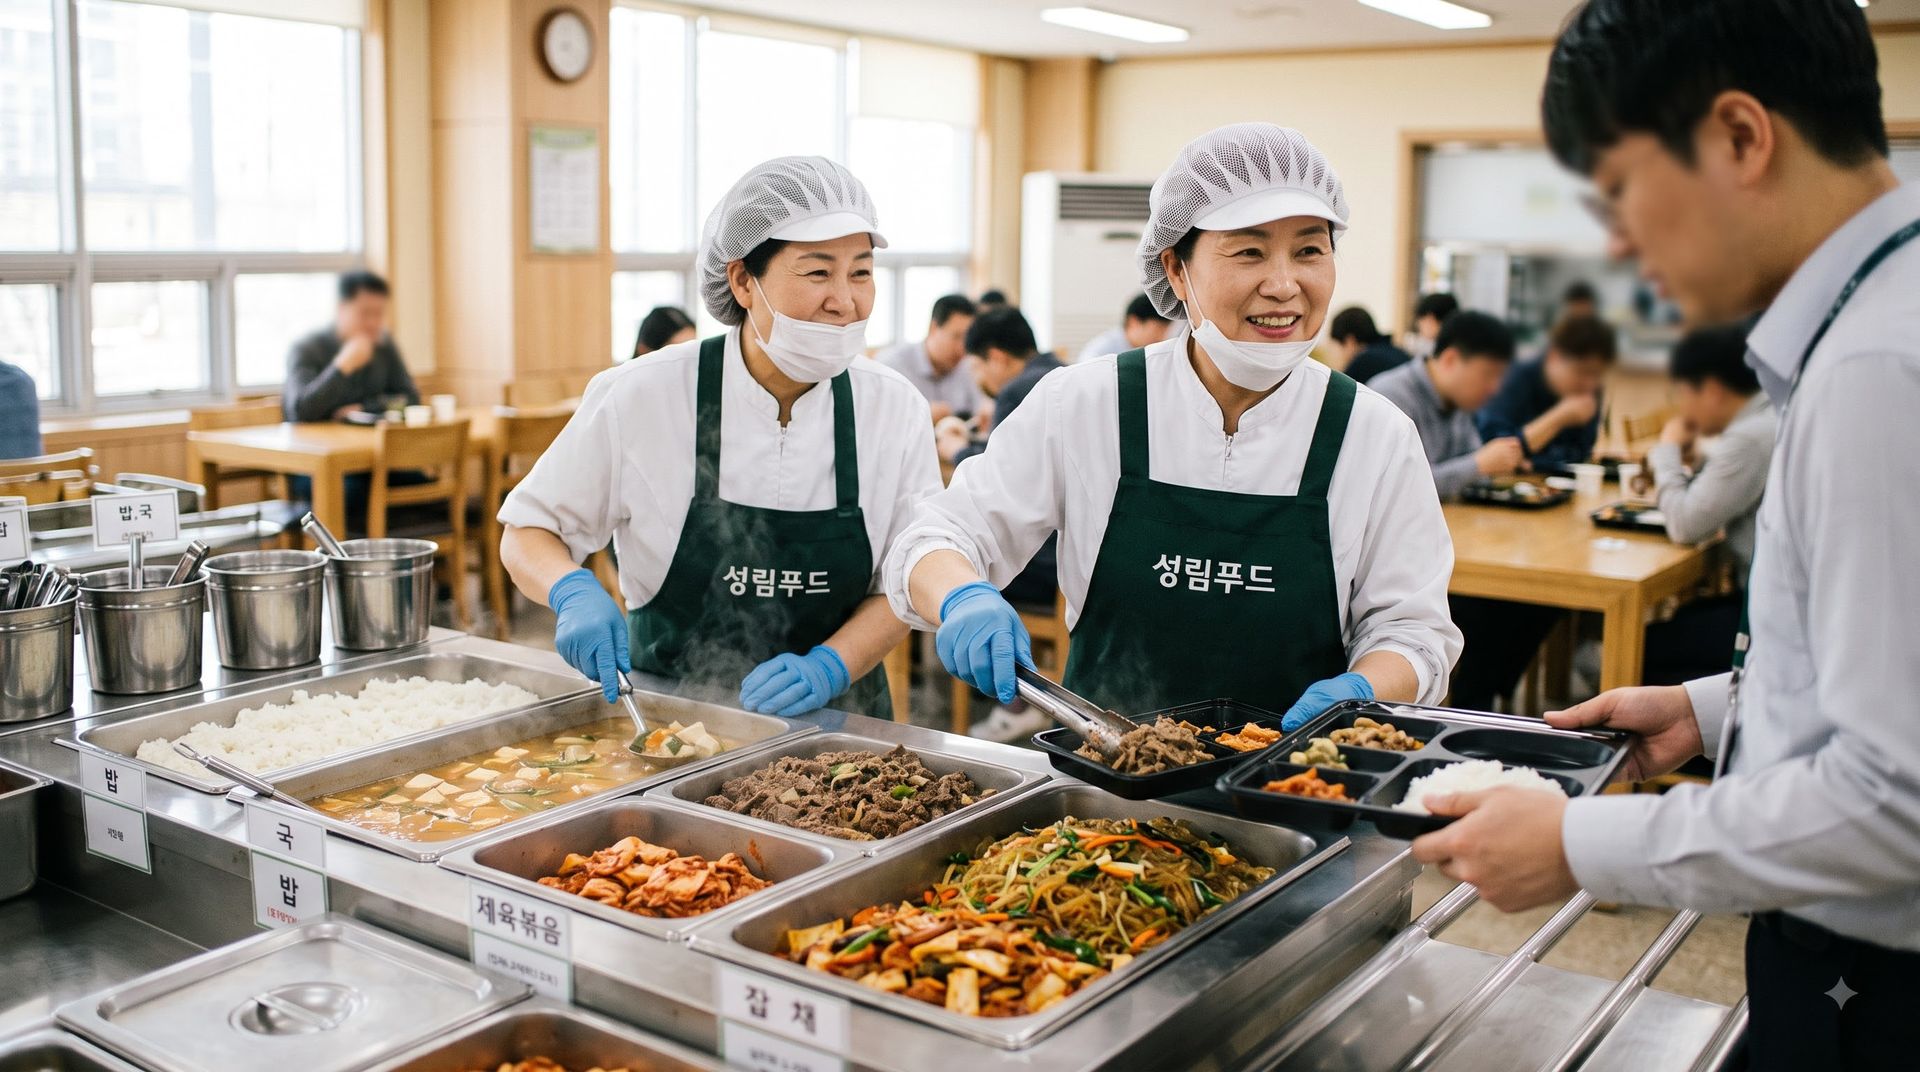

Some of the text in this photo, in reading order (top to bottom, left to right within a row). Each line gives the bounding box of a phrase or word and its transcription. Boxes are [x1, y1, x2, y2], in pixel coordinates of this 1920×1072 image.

[722, 565, 831, 598] 성림푸드
[1152, 554, 1276, 594] 성림푸드
[105, 767, 119, 794] 밥
[276, 822, 294, 851] 국
[280, 874, 299, 908] 밥
[477, 894, 562, 947] 제육볶음
